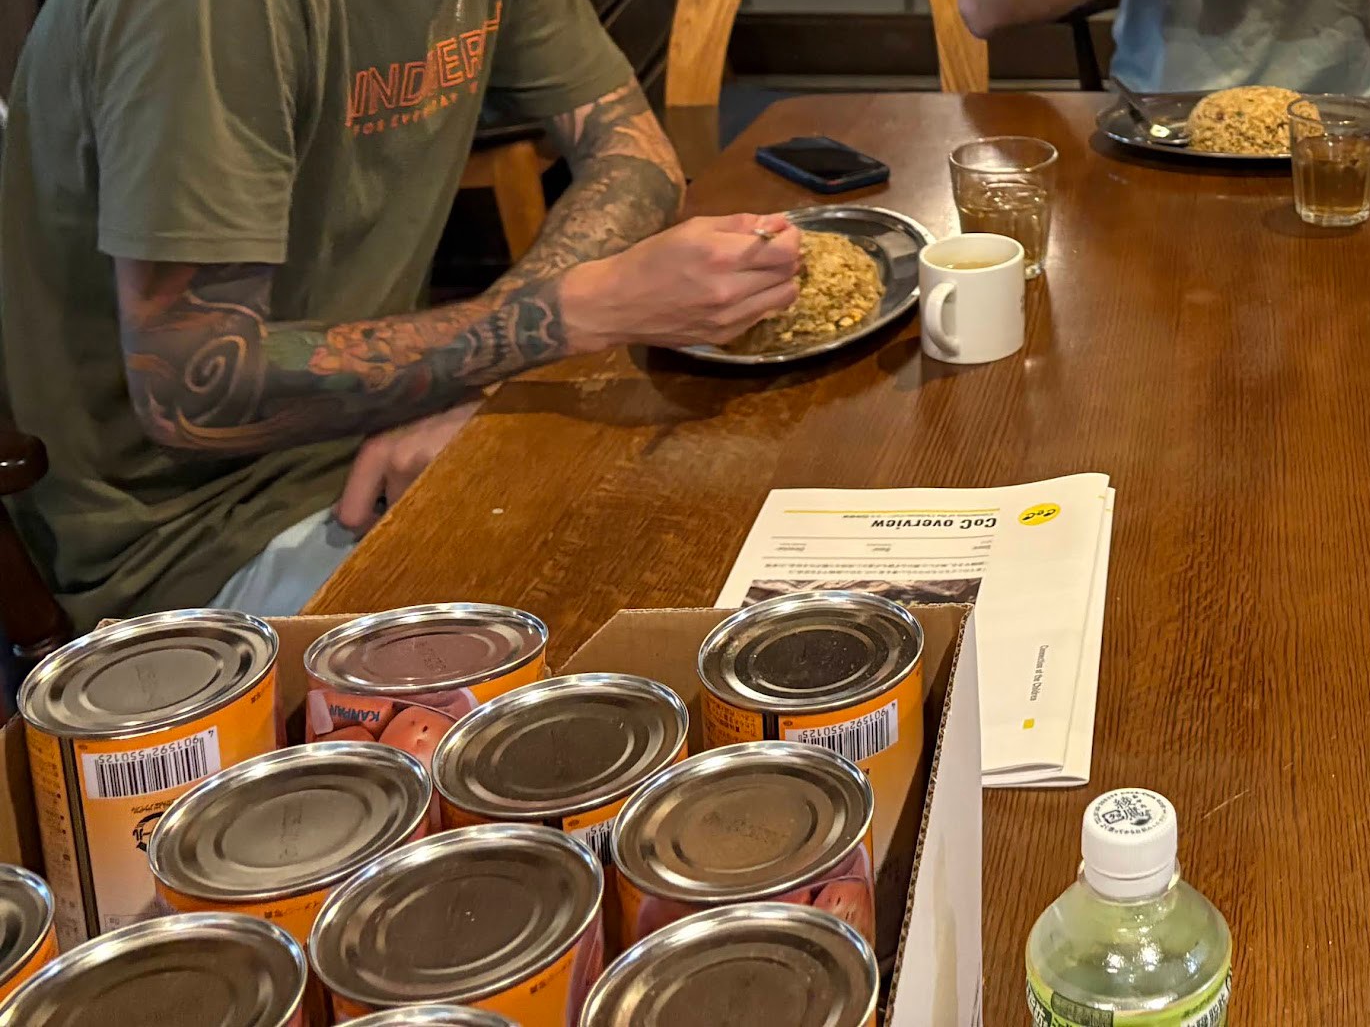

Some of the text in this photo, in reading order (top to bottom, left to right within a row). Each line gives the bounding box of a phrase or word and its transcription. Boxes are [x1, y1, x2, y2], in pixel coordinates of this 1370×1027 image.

[1022, 508, 1057, 522] CoC
[871, 517, 997, 531] CoC overview
[330, 705, 380, 722] KANPAN
[802, 701, 897, 738] 4 901592 550125
[98, 729, 215, 764] 4 901592 550125
[590, 821, 611, 836] 125
